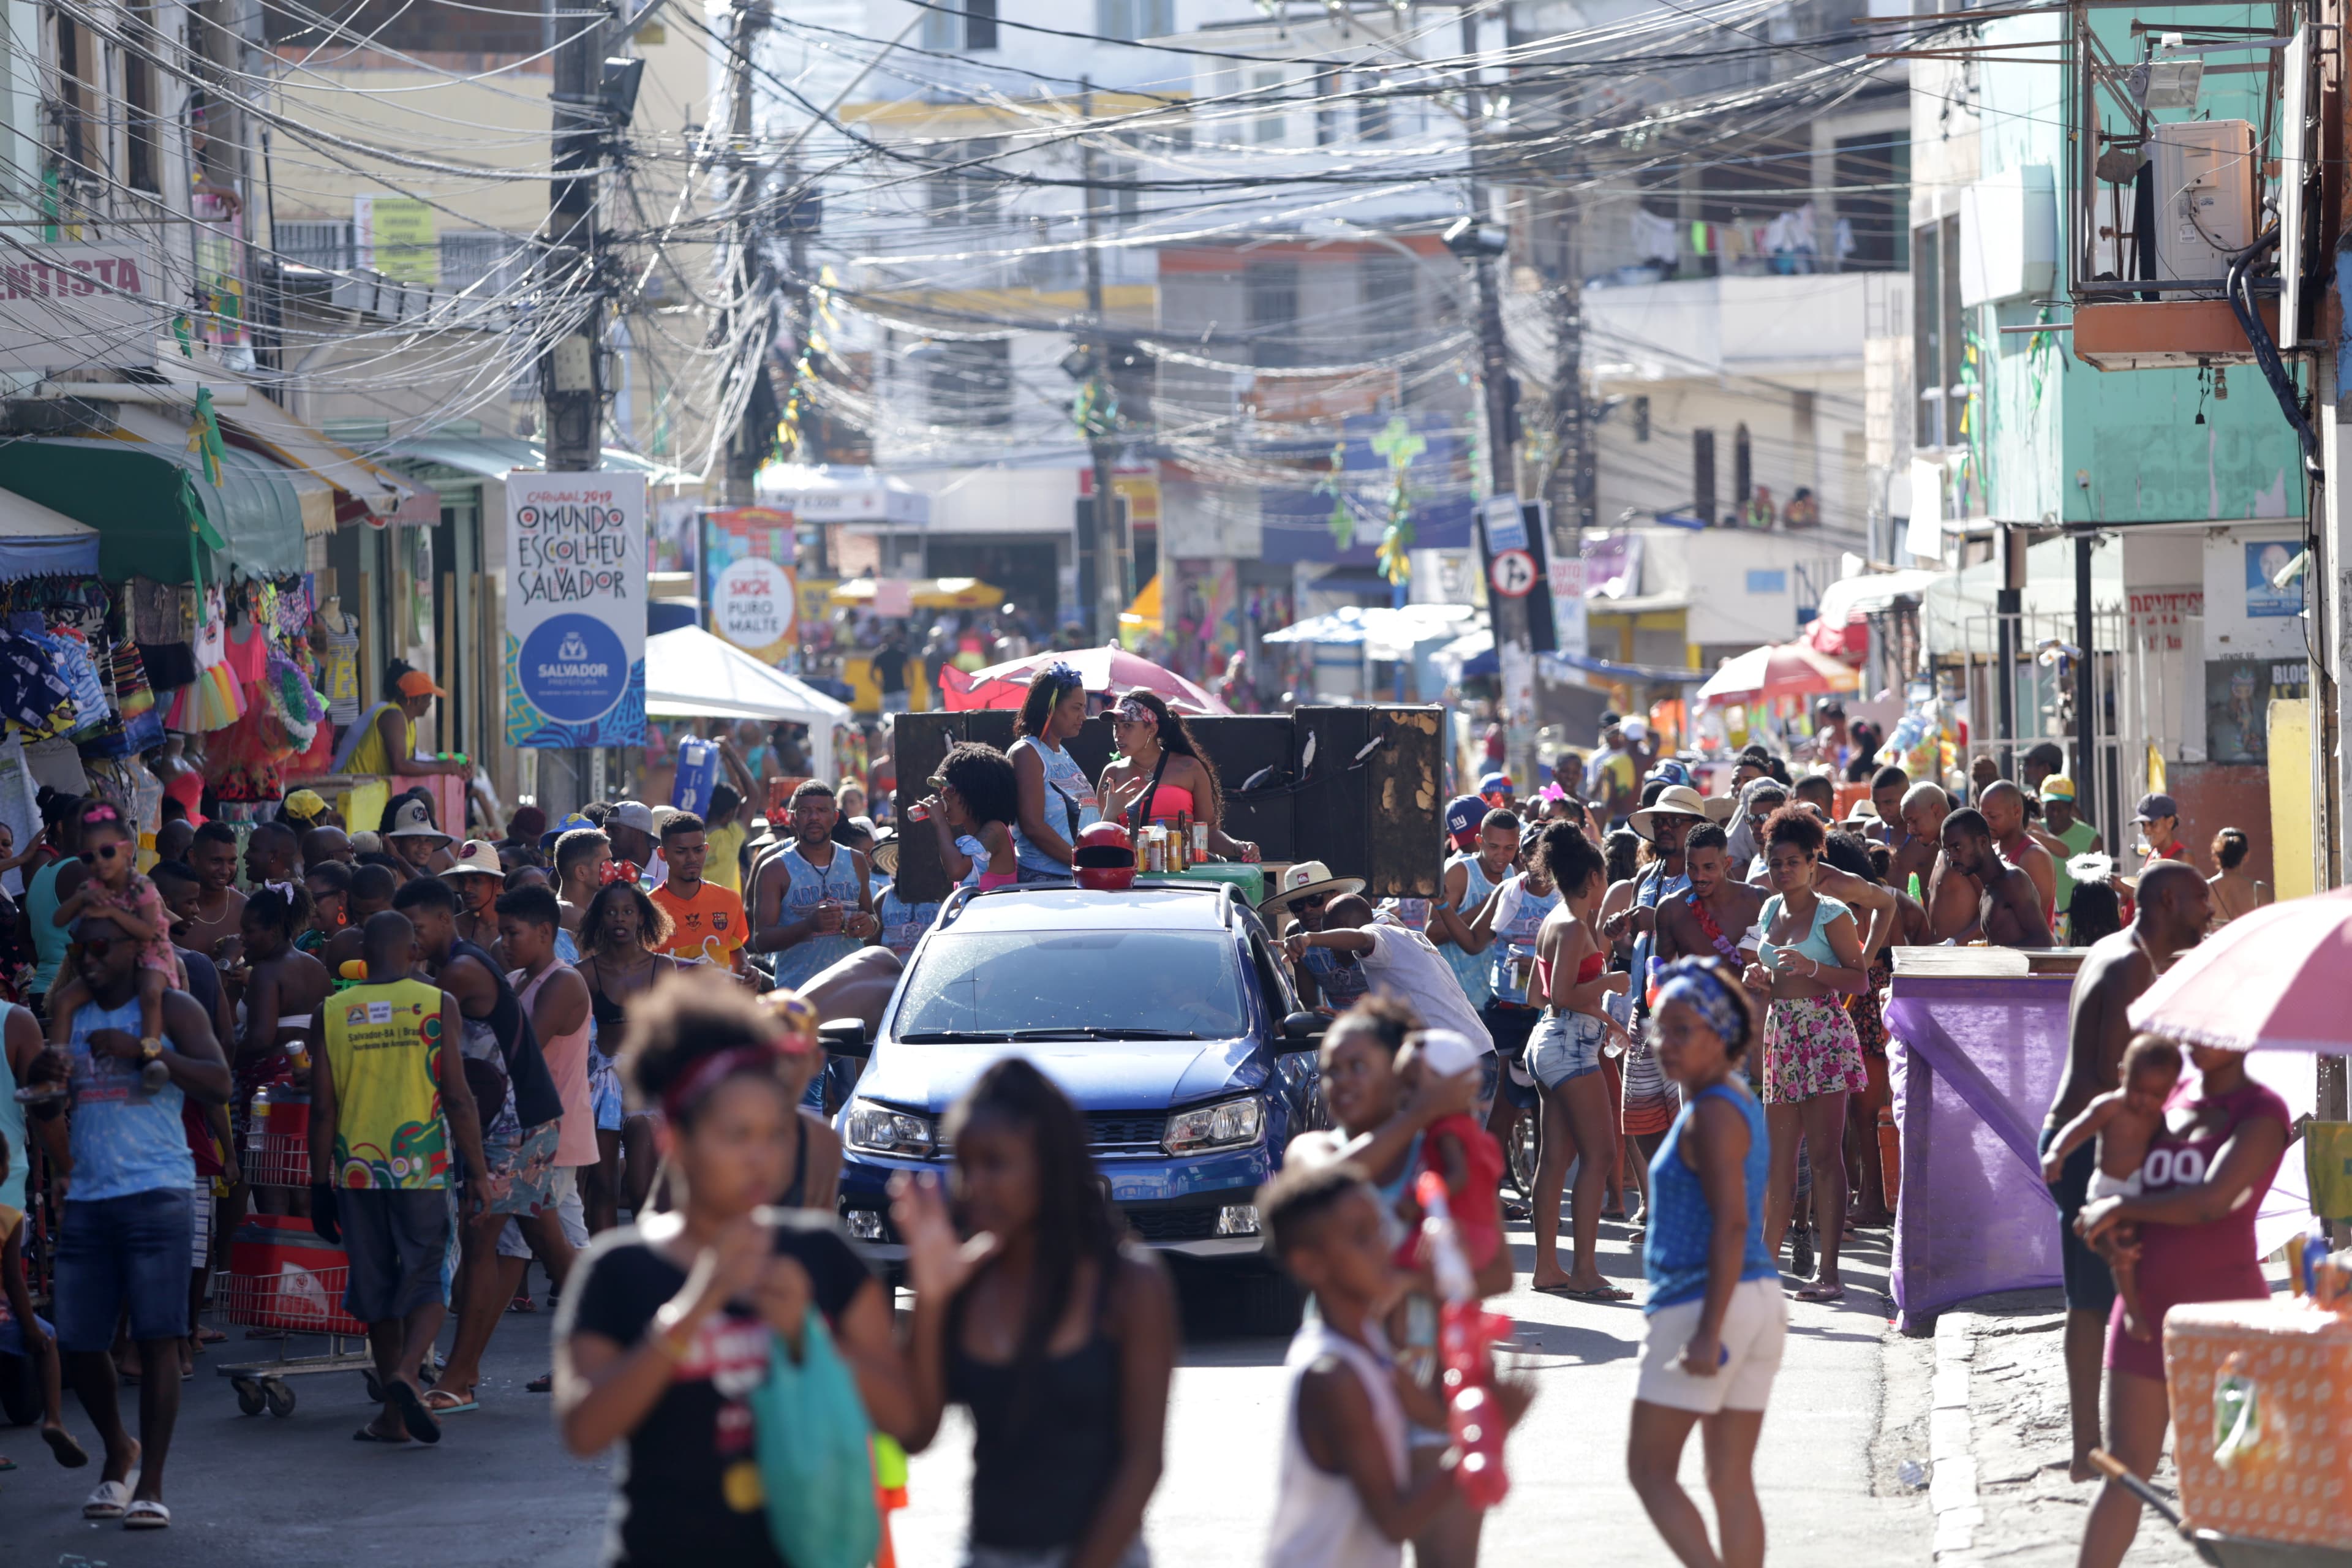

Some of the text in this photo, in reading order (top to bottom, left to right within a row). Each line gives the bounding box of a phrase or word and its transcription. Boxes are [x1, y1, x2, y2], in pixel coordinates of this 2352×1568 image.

[582, 490, 612, 503] 2019
[517, 505, 624, 535] O MUNDO
[519, 534, 625, 569] ESCOLHEU
[518, 567, 626, 605] SALVADOR
[728, 600, 774, 616] PURO
[729, 617, 780, 633] MALTE
[538, 663, 608, 678] SALVADOR
